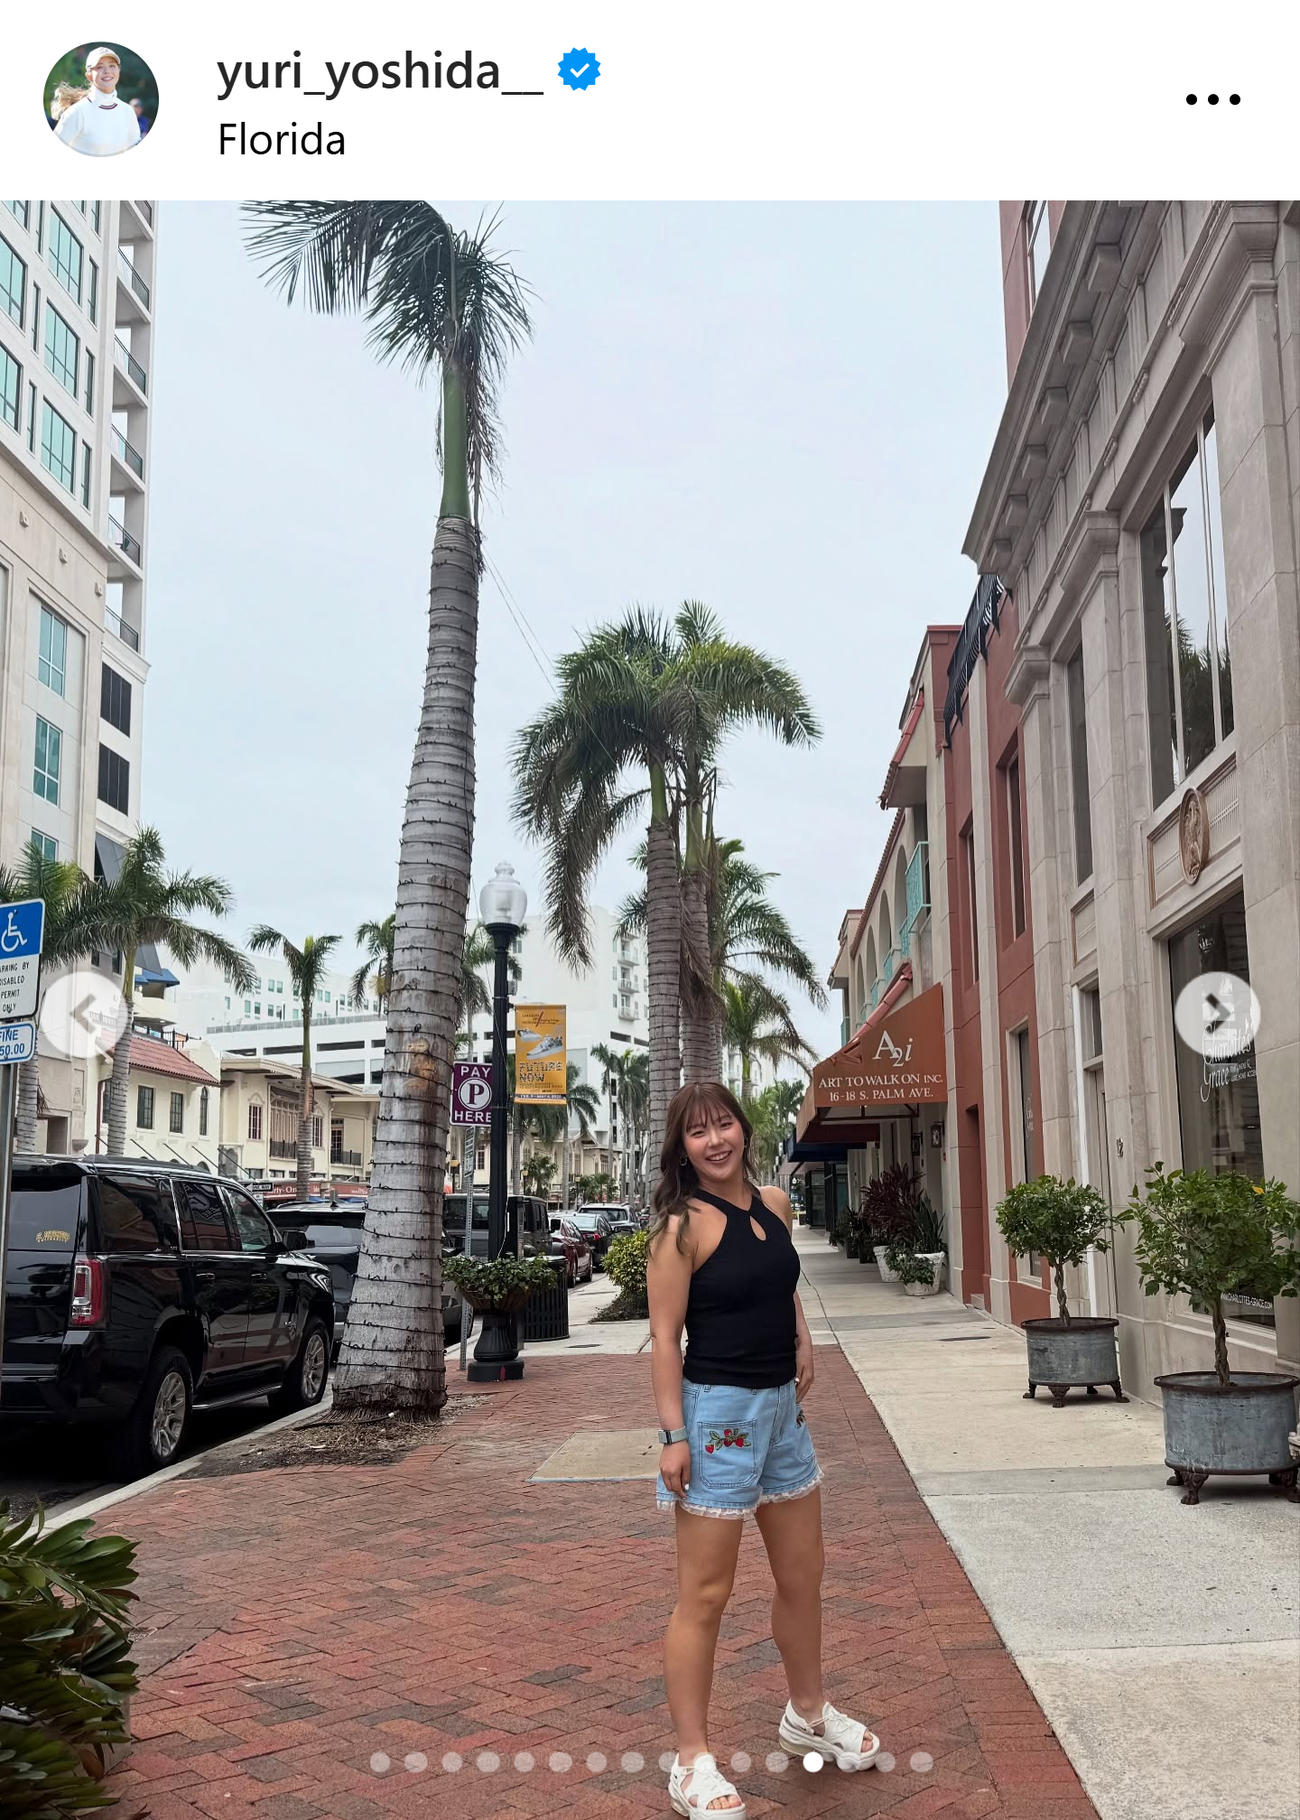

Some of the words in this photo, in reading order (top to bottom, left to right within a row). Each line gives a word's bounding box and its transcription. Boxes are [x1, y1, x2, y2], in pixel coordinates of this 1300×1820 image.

[0, 963, 17, 972] RKING
[1, 989, 19, 999] PERMIT
[461, 1066, 491, 1078] PAY
[520, 1062, 562, 1072] FUTURE
[520, 1073, 545, 1082] NOW
[819, 1077, 842, 1088] ART
[845, 1076, 863, 1087] TO
[865, 1075, 901, 1086] WALK
[901, 1074, 920, 1084] ON
[1201, 1061, 1230, 1102] Grace
[467, 1083, 485, 1104] P
[830, 1091, 856, 1102] 16-18
[860, 1090, 869, 1100] S.
[873, 1089, 905, 1099] PALM
[908, 1088, 933, 1098] AVE.
[454, 1111, 492, 1122] HERE
